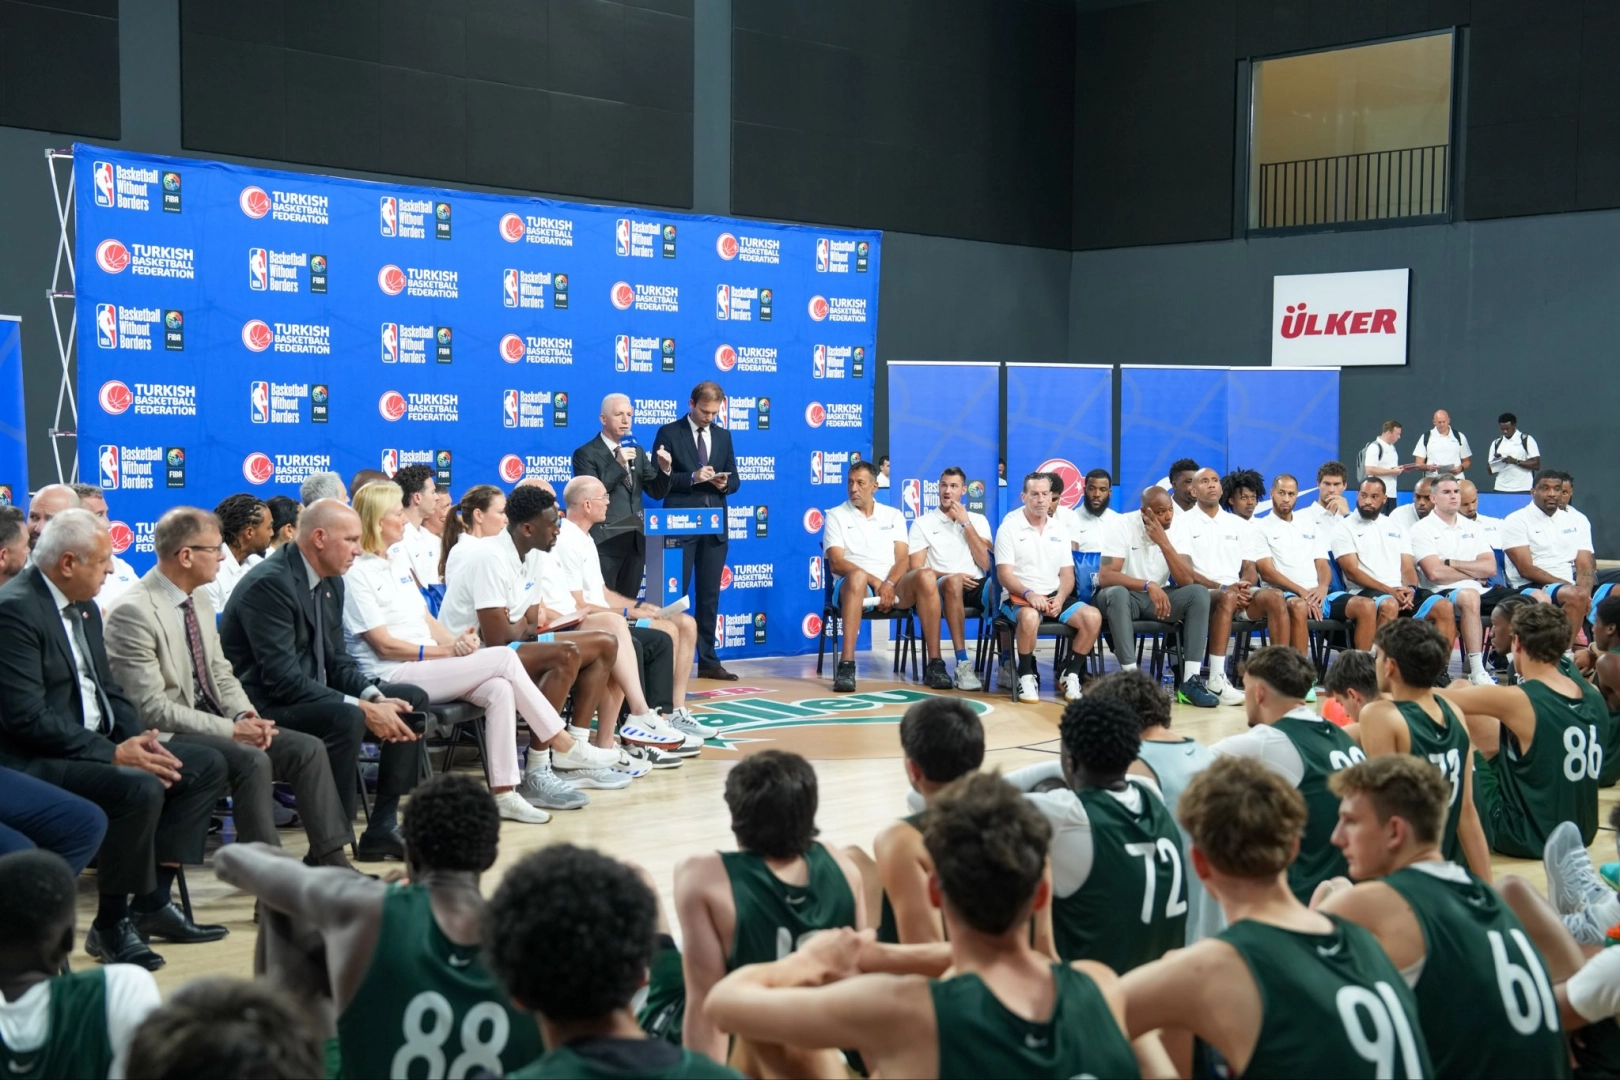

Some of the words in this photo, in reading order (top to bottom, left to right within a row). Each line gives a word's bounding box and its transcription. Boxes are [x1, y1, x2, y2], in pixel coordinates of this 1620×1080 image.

[116, 165, 158, 184] Basketball
[117, 180, 147, 196] Without
[117, 196, 149, 211] Borders
[165, 195, 179, 203] FIBA
[273, 191, 328, 207] TURKISH
[273, 203, 328, 216] BASKETBALL
[399, 199, 432, 214] Basketball
[273, 211, 328, 224] FEDERATION
[399, 212, 424, 226] Without
[526, 216, 572, 229] TURKISH
[399, 224, 424, 238] Borders
[526, 227, 572, 238] BASKETBALL
[526, 235, 572, 246] FEDERATION
[740, 237, 779, 249] TURKISH
[132, 244, 193, 260] TURKISH
[270, 250, 306, 266] Basketball
[740, 247, 779, 256] BASKETBALL
[132, 256, 193, 269] BASKETBALL
[740, 254, 779, 264] FEDERATION
[132, 266, 193, 279] FEDERATION
[270, 265, 296, 279] Without
[408, 268, 458, 282] TURKISH
[520, 271, 551, 284] Basketball
[270, 279, 298, 292] Borders
[408, 280, 458, 290] BASKETBALL
[520, 284, 543, 296] Without
[636, 284, 678, 297] TURKISH
[408, 287, 458, 298] FEDERATION
[636, 295, 678, 304] BASKETBALL
[829, 298, 866, 308] TURKISH
[636, 302, 678, 312] FEDERATION
[829, 307, 866, 315] BASKETBALL
[119, 306, 160, 322] Basketball
[829, 314, 866, 322] FEDERATION
[1281, 302, 1397, 339] ÜLKER
[119, 321, 150, 336] Without
[274, 323, 329, 337] TURKISH
[400, 325, 433, 339] Basketball
[120, 335, 151, 350] Borders
[274, 335, 329, 345] BASKETBALL
[400, 338, 424, 351] Without
[526, 337, 572, 349] TURKISH
[274, 344, 329, 354] FEDERATION
[526, 347, 572, 356] BASKETBALL
[738, 347, 777, 358] TURKISH
[400, 351, 426, 364] Borders
[526, 355, 572, 364] FEDERATION
[738, 364, 777, 372] FEDERATION
[134, 384, 196, 397] TURKISH
[271, 383, 308, 397] Basketball
[134, 397, 196, 406] BASKETBALL
[271, 396, 298, 410] Without
[408, 393, 458, 405] TURKISH
[520, 391, 551, 404] Basketball
[134, 406, 196, 416] FEDERATION
[408, 405, 458, 413] BASKETBALL
[520, 403, 543, 416] Without
[635, 400, 676, 409] TURKISH
[826, 404, 862, 413] TURKISH
[271, 410, 299, 424] Borders
[408, 413, 458, 421] FEDERATION
[121, 446, 162, 461] Basketball
[400, 450, 433, 463] Basketball
[275, 455, 330, 466] TURKISH
[525, 456, 571, 466] TURKISH
[736, 457, 774, 465] TURKISH
[121, 461, 151, 475] Without
[121, 475, 153, 489] Borders
[734, 564, 773, 574] TURKISH
[1563, 724, 1602, 782] 86
[1124, 838, 1188, 924] 72
[1488, 928, 1559, 1035] 61
[390, 990, 510, 1080] 88
[1336, 981, 1422, 1080] 91
